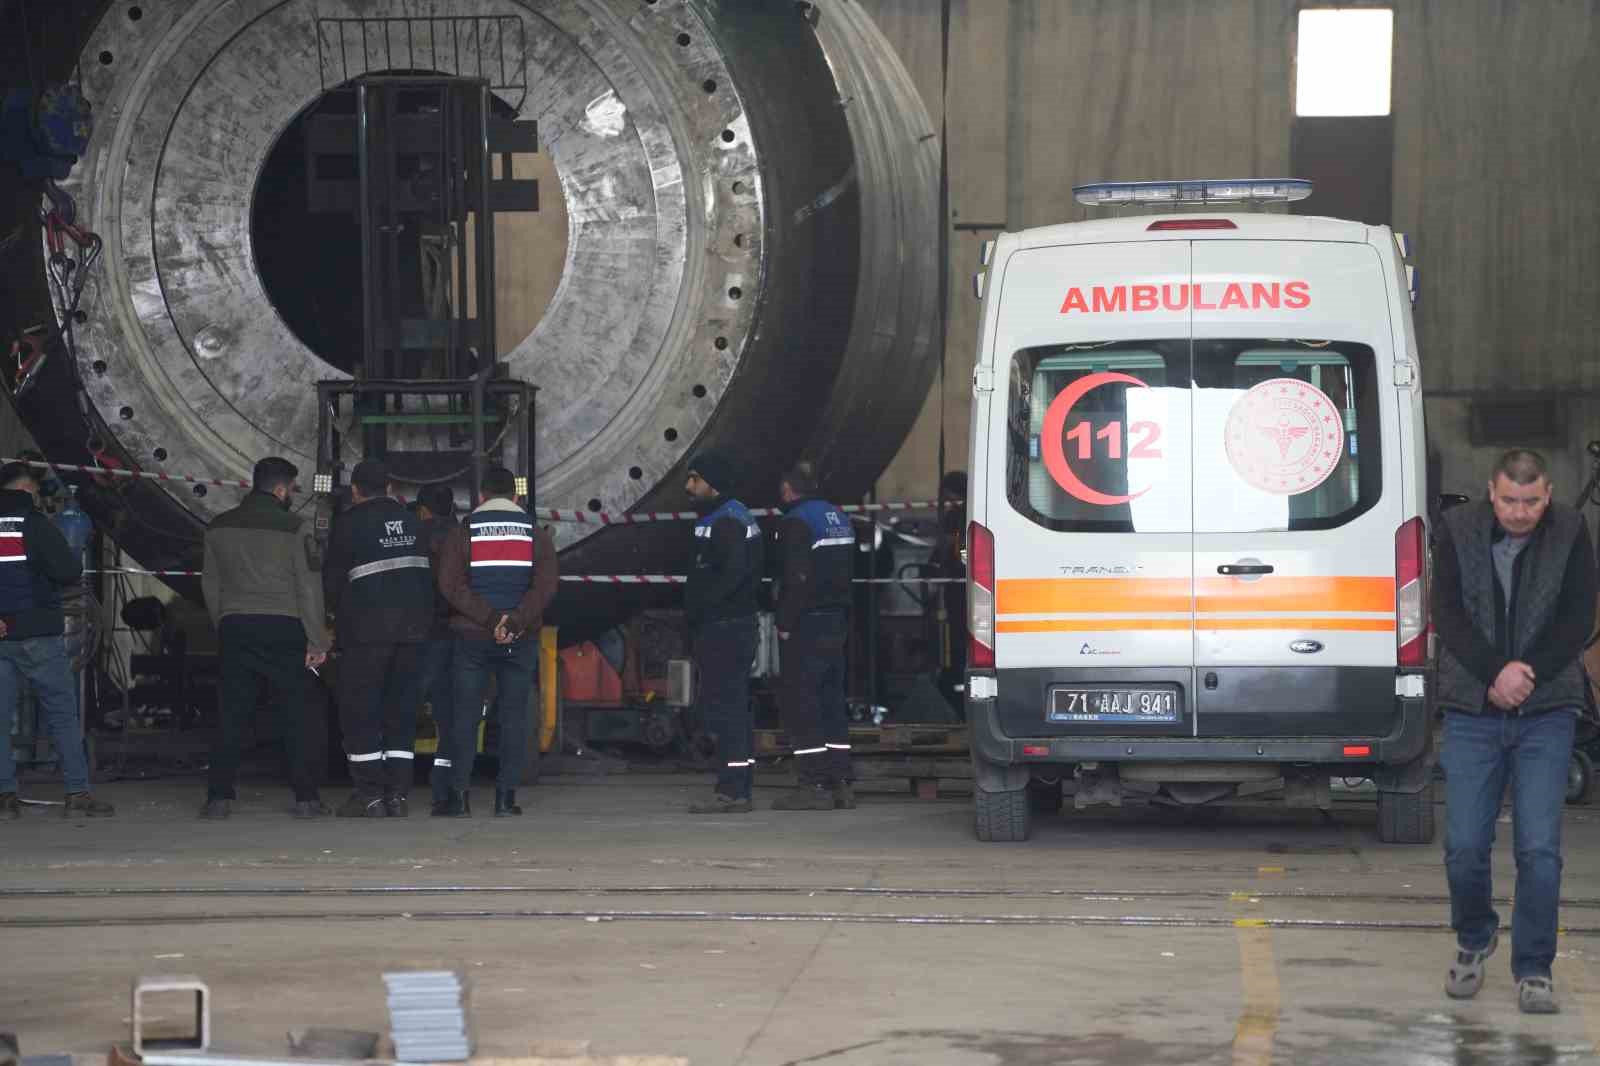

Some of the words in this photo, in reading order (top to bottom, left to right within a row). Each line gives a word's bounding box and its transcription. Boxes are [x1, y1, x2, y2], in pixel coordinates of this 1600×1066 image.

[1060, 282, 1311, 313] AMBULANS
[1066, 421, 1162, 459] 112
[1059, 566, 1144, 577] TRANS
[1067, 693, 1088, 713] 71
[1100, 693, 1132, 713] AAJ
[1140, 693, 1171, 713] 941
